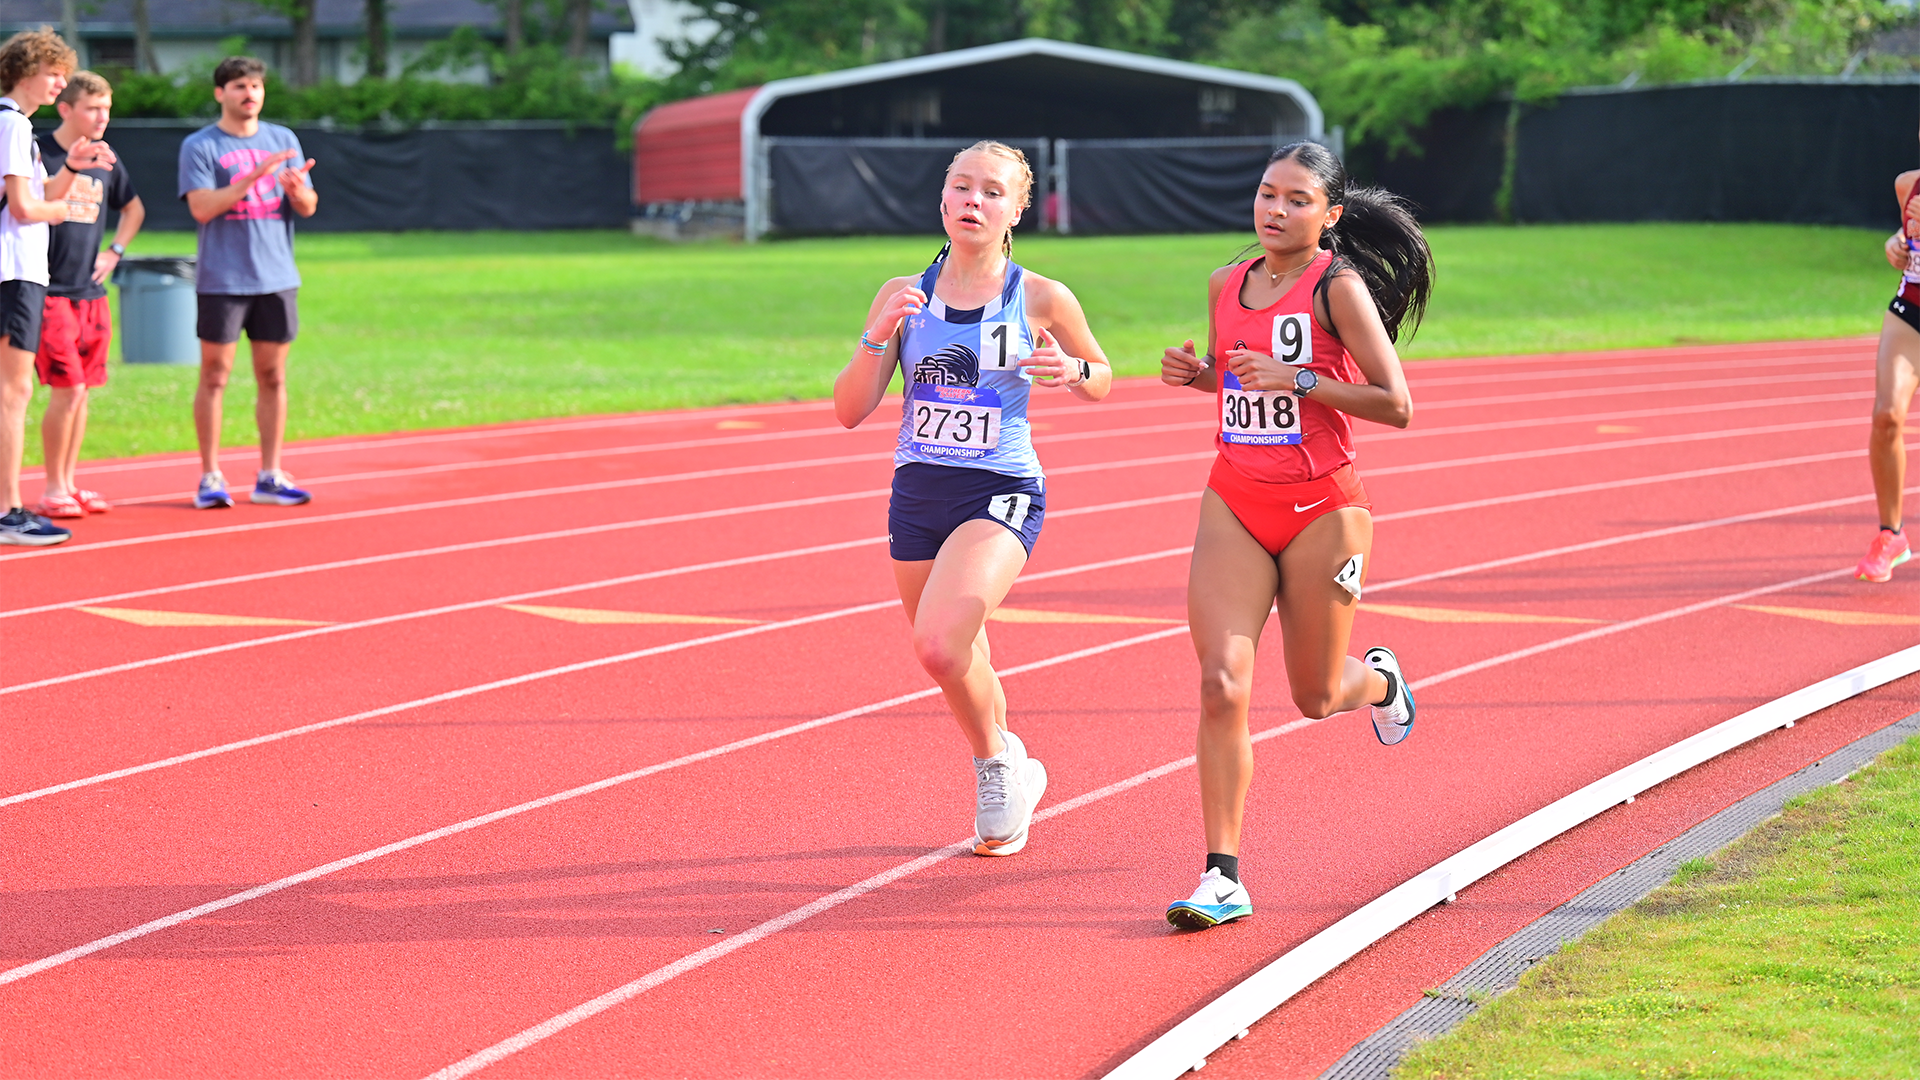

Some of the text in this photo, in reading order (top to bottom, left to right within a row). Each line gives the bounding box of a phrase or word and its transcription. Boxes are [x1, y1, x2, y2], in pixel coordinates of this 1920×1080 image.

[991, 325, 1006, 367] 1
[1280, 317, 1303, 362] 9
[935, 385, 973, 395] SOUTHERN
[938, 391, 966, 400] STATES
[917, 406, 990, 444] 2731
[1226, 394, 1295, 429] 3018
[920, 444, 986, 458] CHAMPIONSHIPS
[1230, 434, 1289, 444] CHAMPIONSHIPS
[1002, 496, 1018, 523] 1
